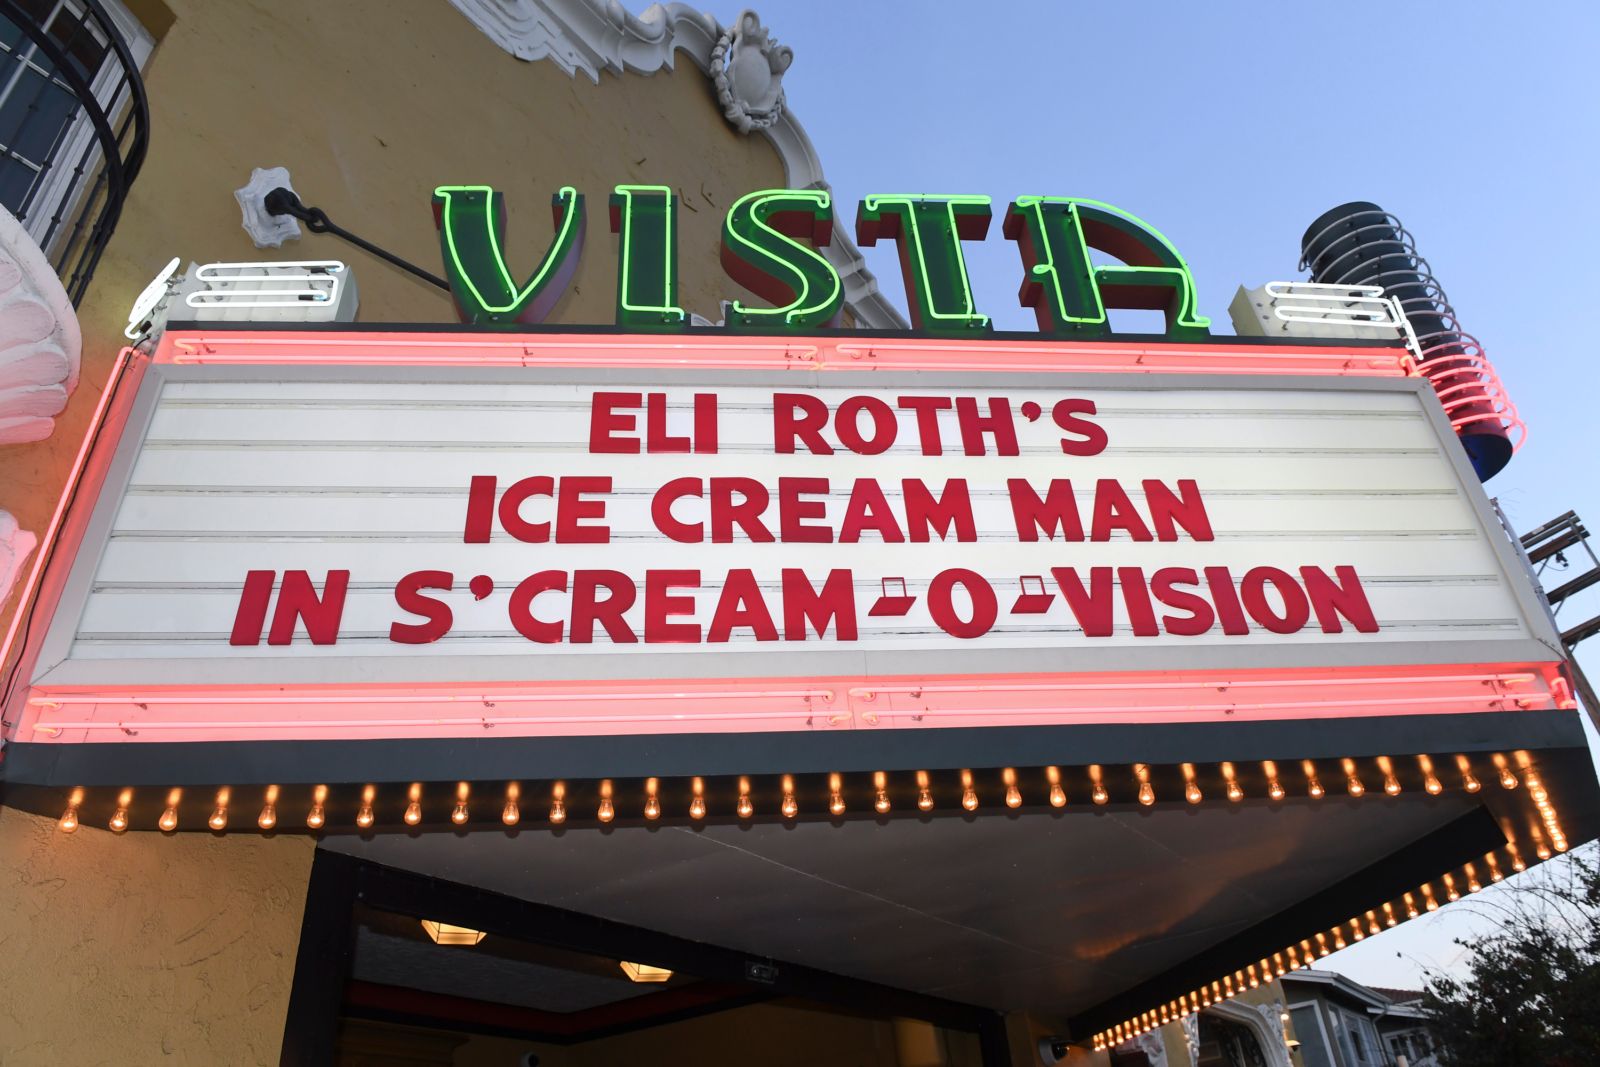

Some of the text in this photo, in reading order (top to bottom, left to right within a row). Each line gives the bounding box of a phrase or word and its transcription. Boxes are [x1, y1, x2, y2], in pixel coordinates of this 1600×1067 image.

[432, 184, 1212, 334] VISTA
[590, 393, 1108, 457] ELI ROTH'S
[465, 476, 1214, 544] ICE CREAM MAN
[230, 570, 350, 646] IN
